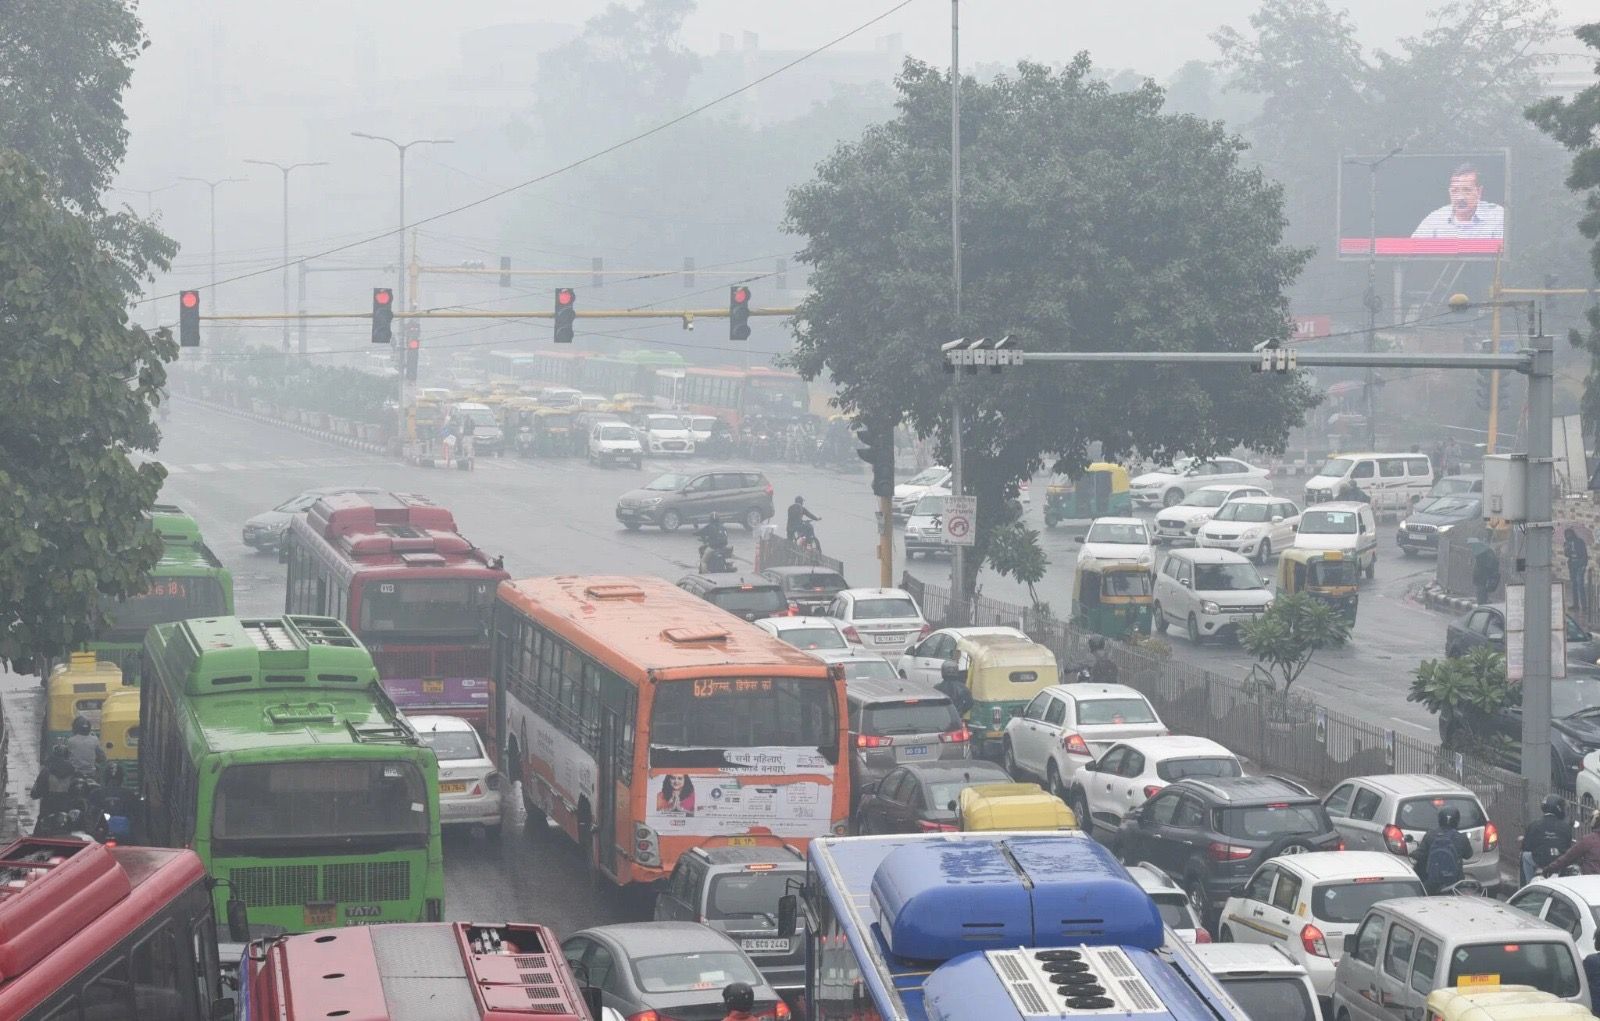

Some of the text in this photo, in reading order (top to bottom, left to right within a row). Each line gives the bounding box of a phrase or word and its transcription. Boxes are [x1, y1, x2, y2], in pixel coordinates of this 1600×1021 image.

[694, 679, 713, 697] 623
[349, 905, 380, 917] TATA
[746, 940, 754, 949] DL
